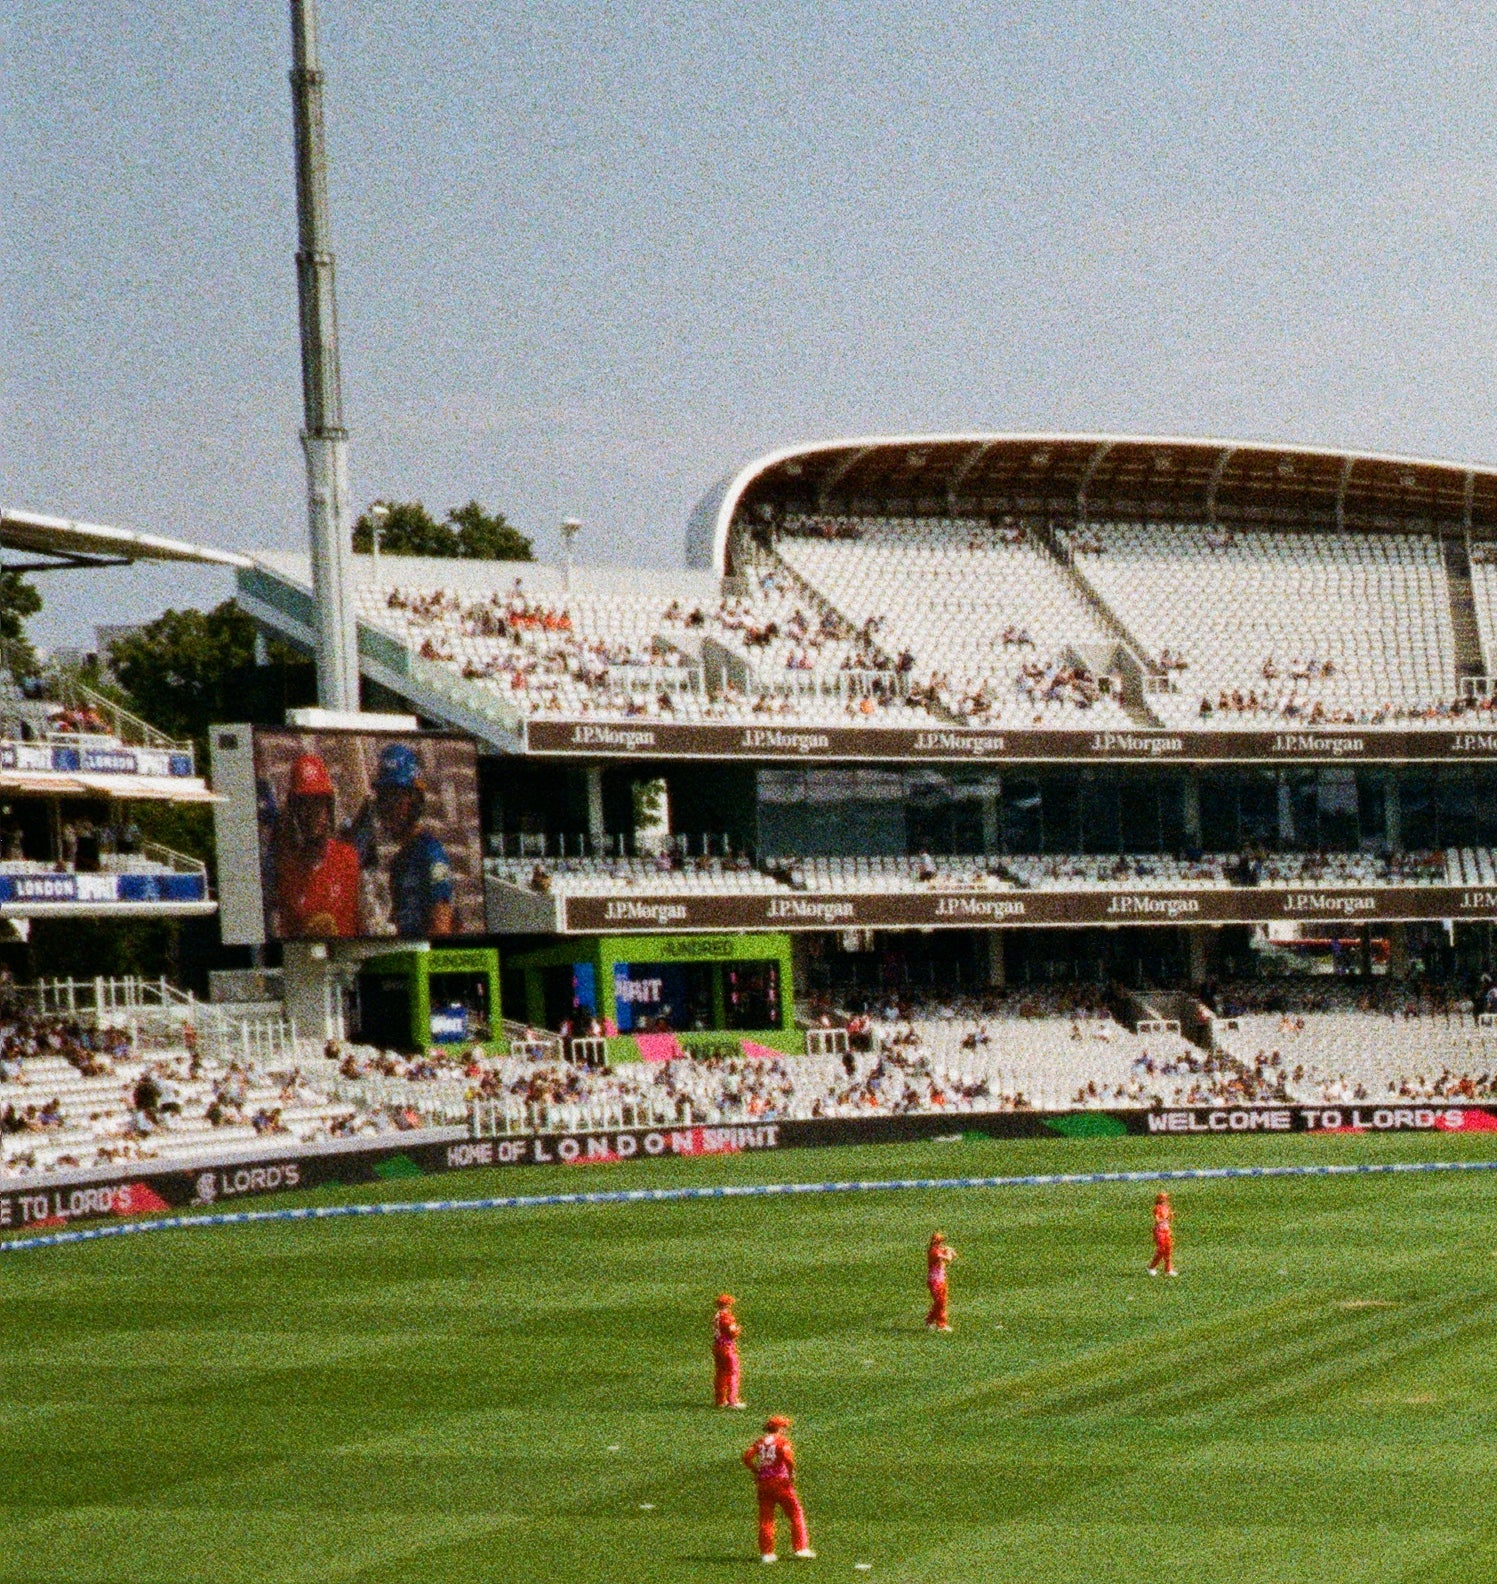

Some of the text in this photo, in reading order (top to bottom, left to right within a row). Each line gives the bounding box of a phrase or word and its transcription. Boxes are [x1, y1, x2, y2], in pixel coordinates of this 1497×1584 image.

[571, 727, 655, 748] J.P.Morgan
[742, 730, 828, 750] J.P.Morgan
[914, 731, 1003, 753] J.P.Morgan
[1092, 732, 1182, 753] J.P.Morgan
[1272, 733, 1363, 754] J.P.Morgan
[604, 901, 687, 923] J.P.Morgan
[766, 900, 853, 920] J.P.Morgan
[935, 898, 1025, 918] J.P.Morgan
[1107, 896, 1199, 917] J.P.Morgan
[1284, 895, 1375, 914] J.P.Morgan
[1148, 1109, 1465, 1132] WELCOME TO LORD'S
[449, 1143, 492, 1166] HOME
[498, 1141, 526, 1161] OF
[536, 1129, 694, 1162] LONDON
[222, 1164, 300, 1194] LORD'S
[20, 1197, 48, 1219] TO
[56, 1184, 132, 1217] LORD'S
